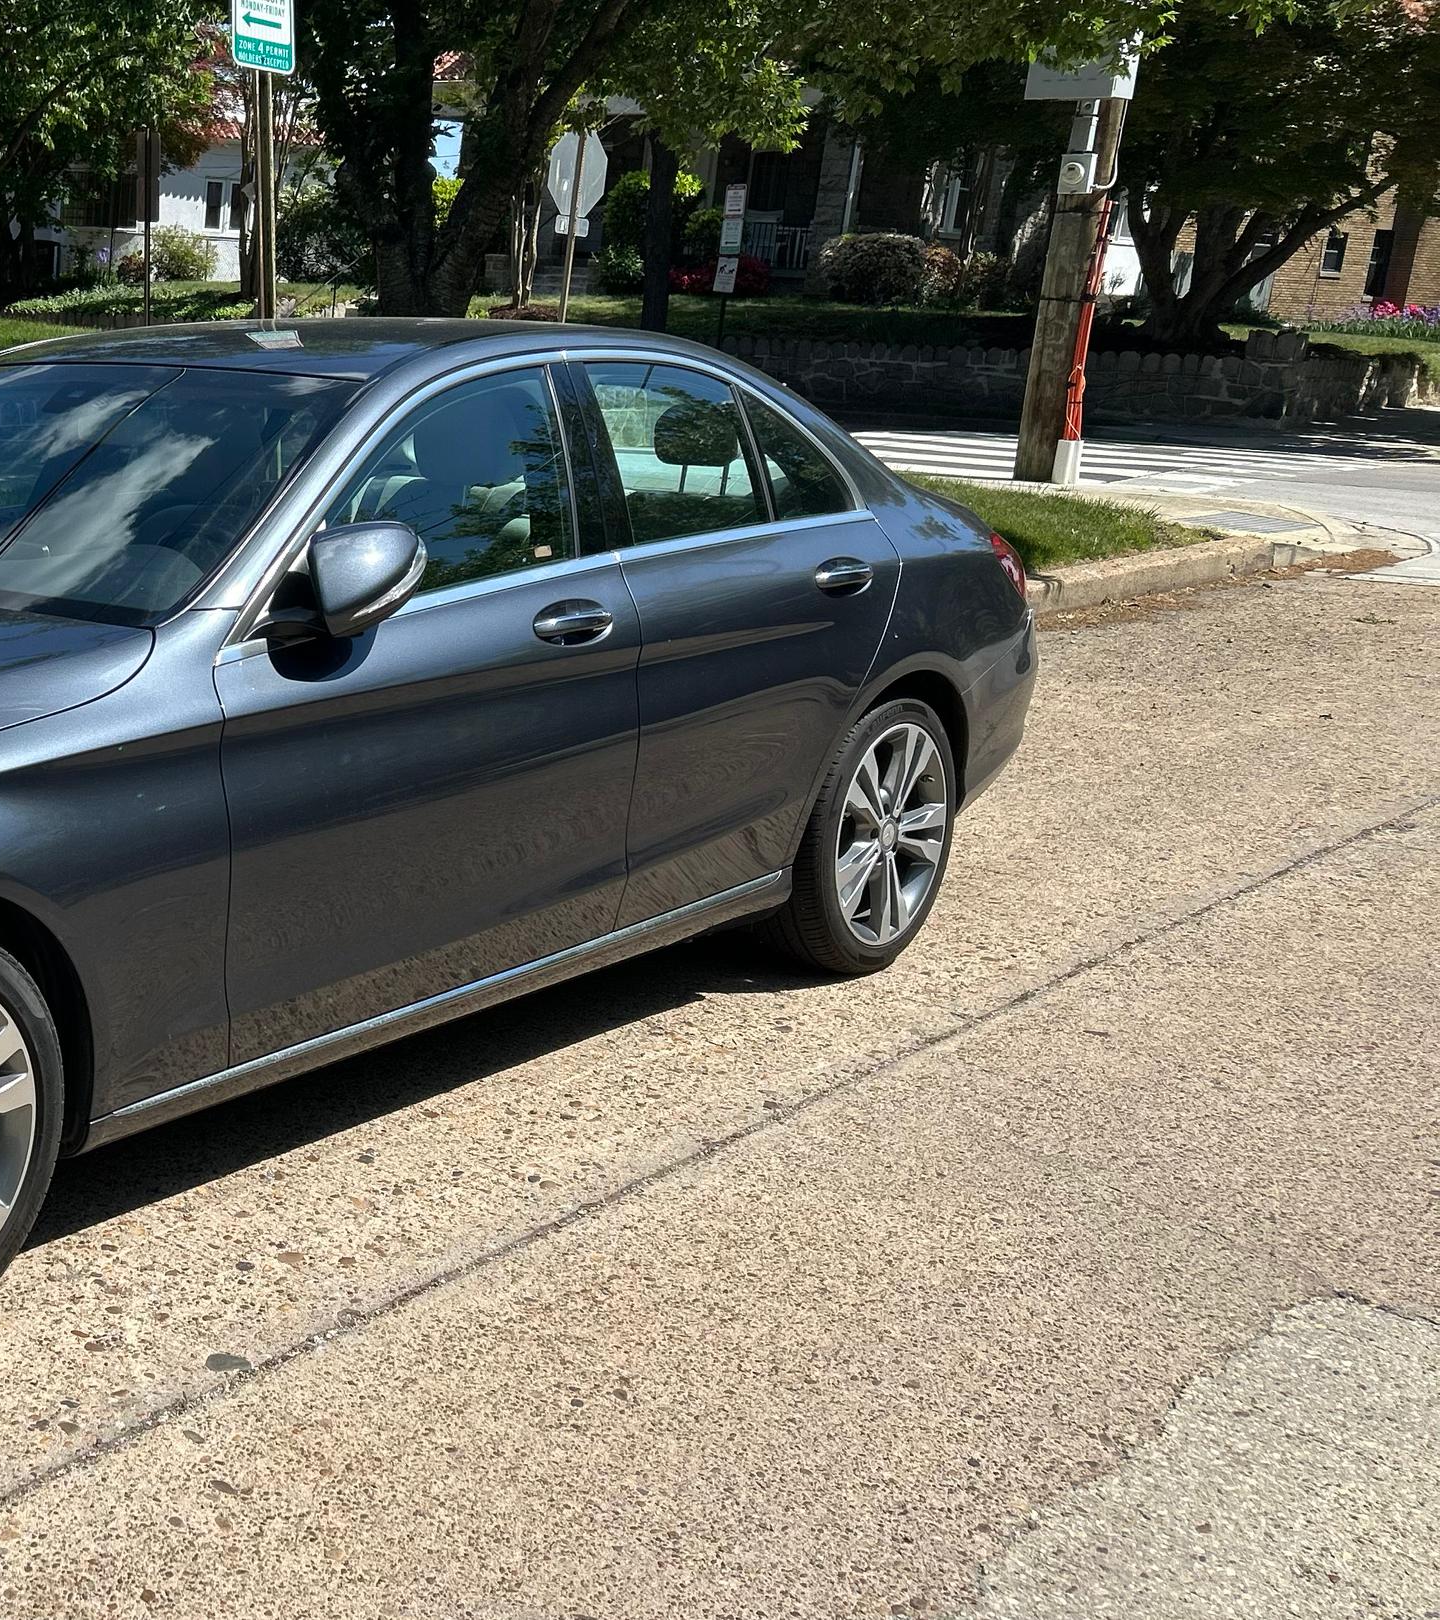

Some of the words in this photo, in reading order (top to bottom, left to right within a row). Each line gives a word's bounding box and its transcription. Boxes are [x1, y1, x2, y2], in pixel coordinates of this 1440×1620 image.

[240, 0, 285, 17] MONDAY-FRIDAY
[238, 40, 256, 51] ZONE
[258, 42, 264, 54] 4
[265, 45, 289, 58] PERMIT
[238, 51, 262, 64] HOLDERS
